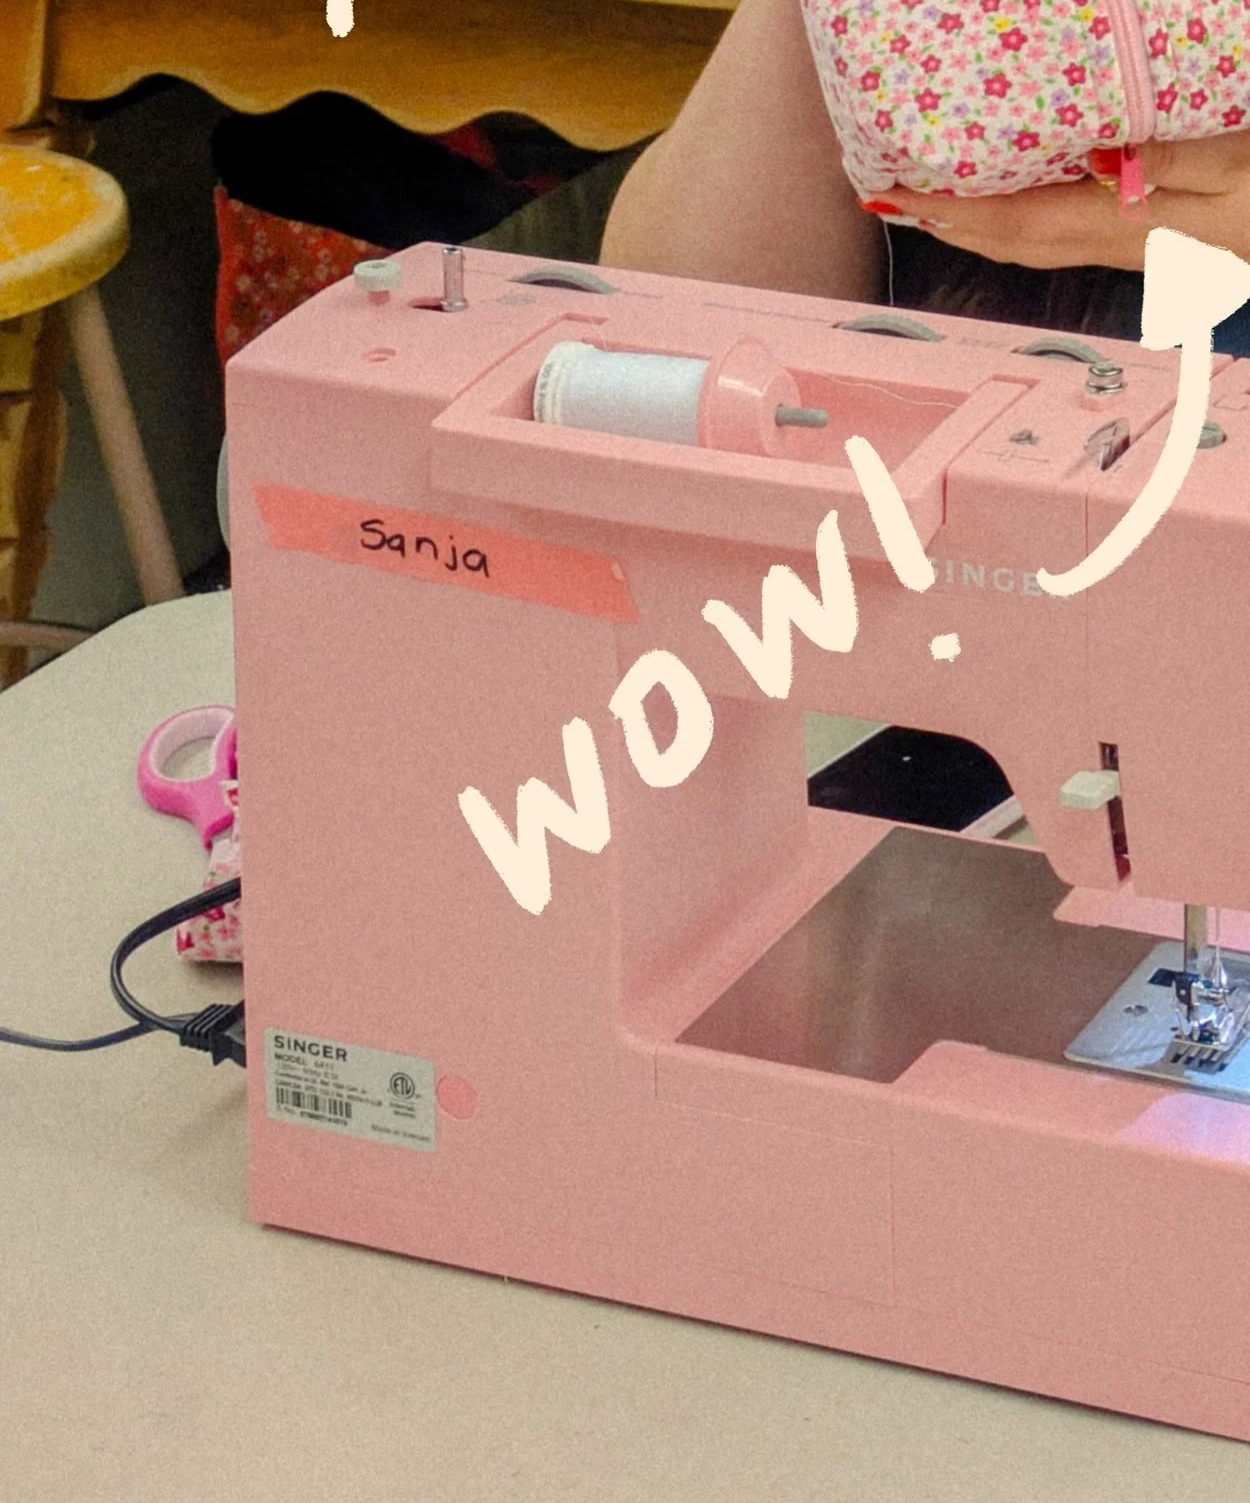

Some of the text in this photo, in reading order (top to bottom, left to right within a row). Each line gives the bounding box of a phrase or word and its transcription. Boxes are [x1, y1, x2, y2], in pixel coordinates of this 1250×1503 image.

[360, 519, 489, 578] Sanja
[928, 556, 1072, 601] INGE
[274, 1034, 348, 1062] SINGER
